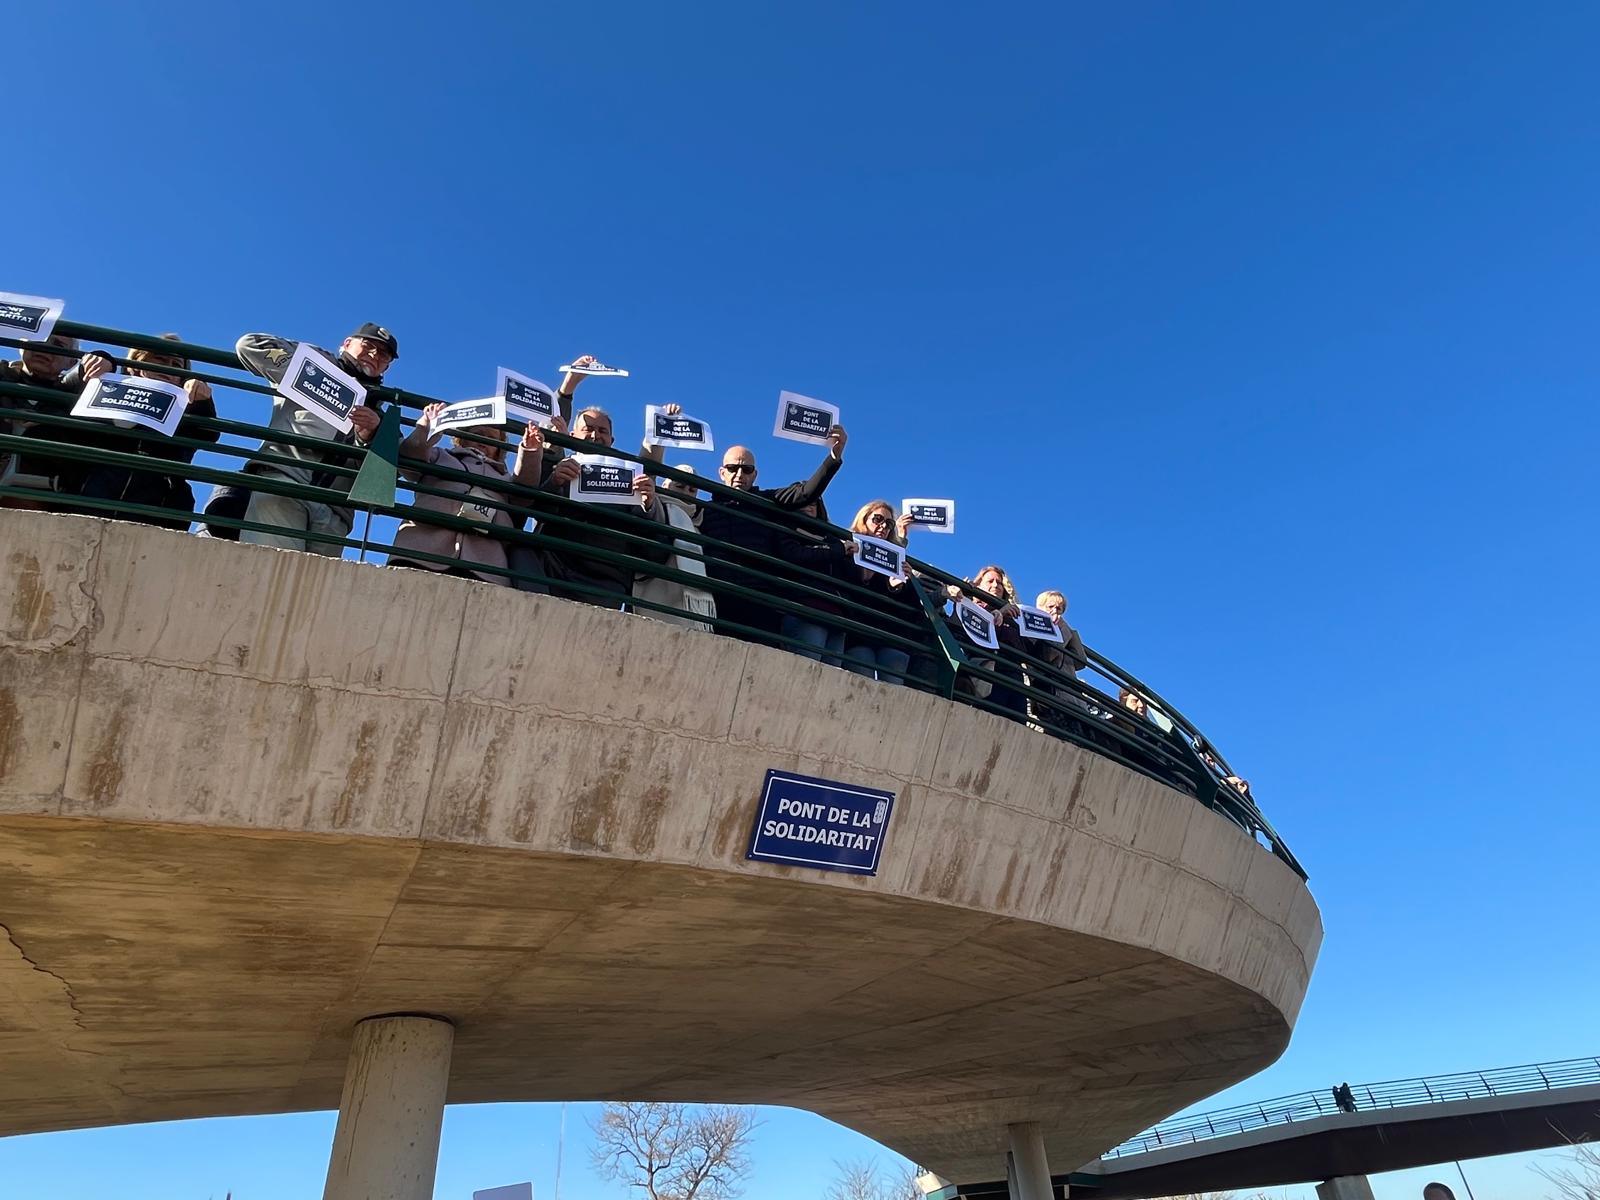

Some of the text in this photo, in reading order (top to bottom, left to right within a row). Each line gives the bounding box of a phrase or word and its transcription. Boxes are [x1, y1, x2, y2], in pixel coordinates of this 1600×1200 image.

[320, 384, 339, 398] DE LA
[322, 377, 341, 390] PONT
[126, 388, 152, 398] PONT
[302, 381, 348, 411] SOLIDARITAT
[100, 398, 162, 414] SOLIDARITAT
[778, 798, 871, 828] PONT DE LA
[763, 820, 875, 850] SOLIDARITAT
